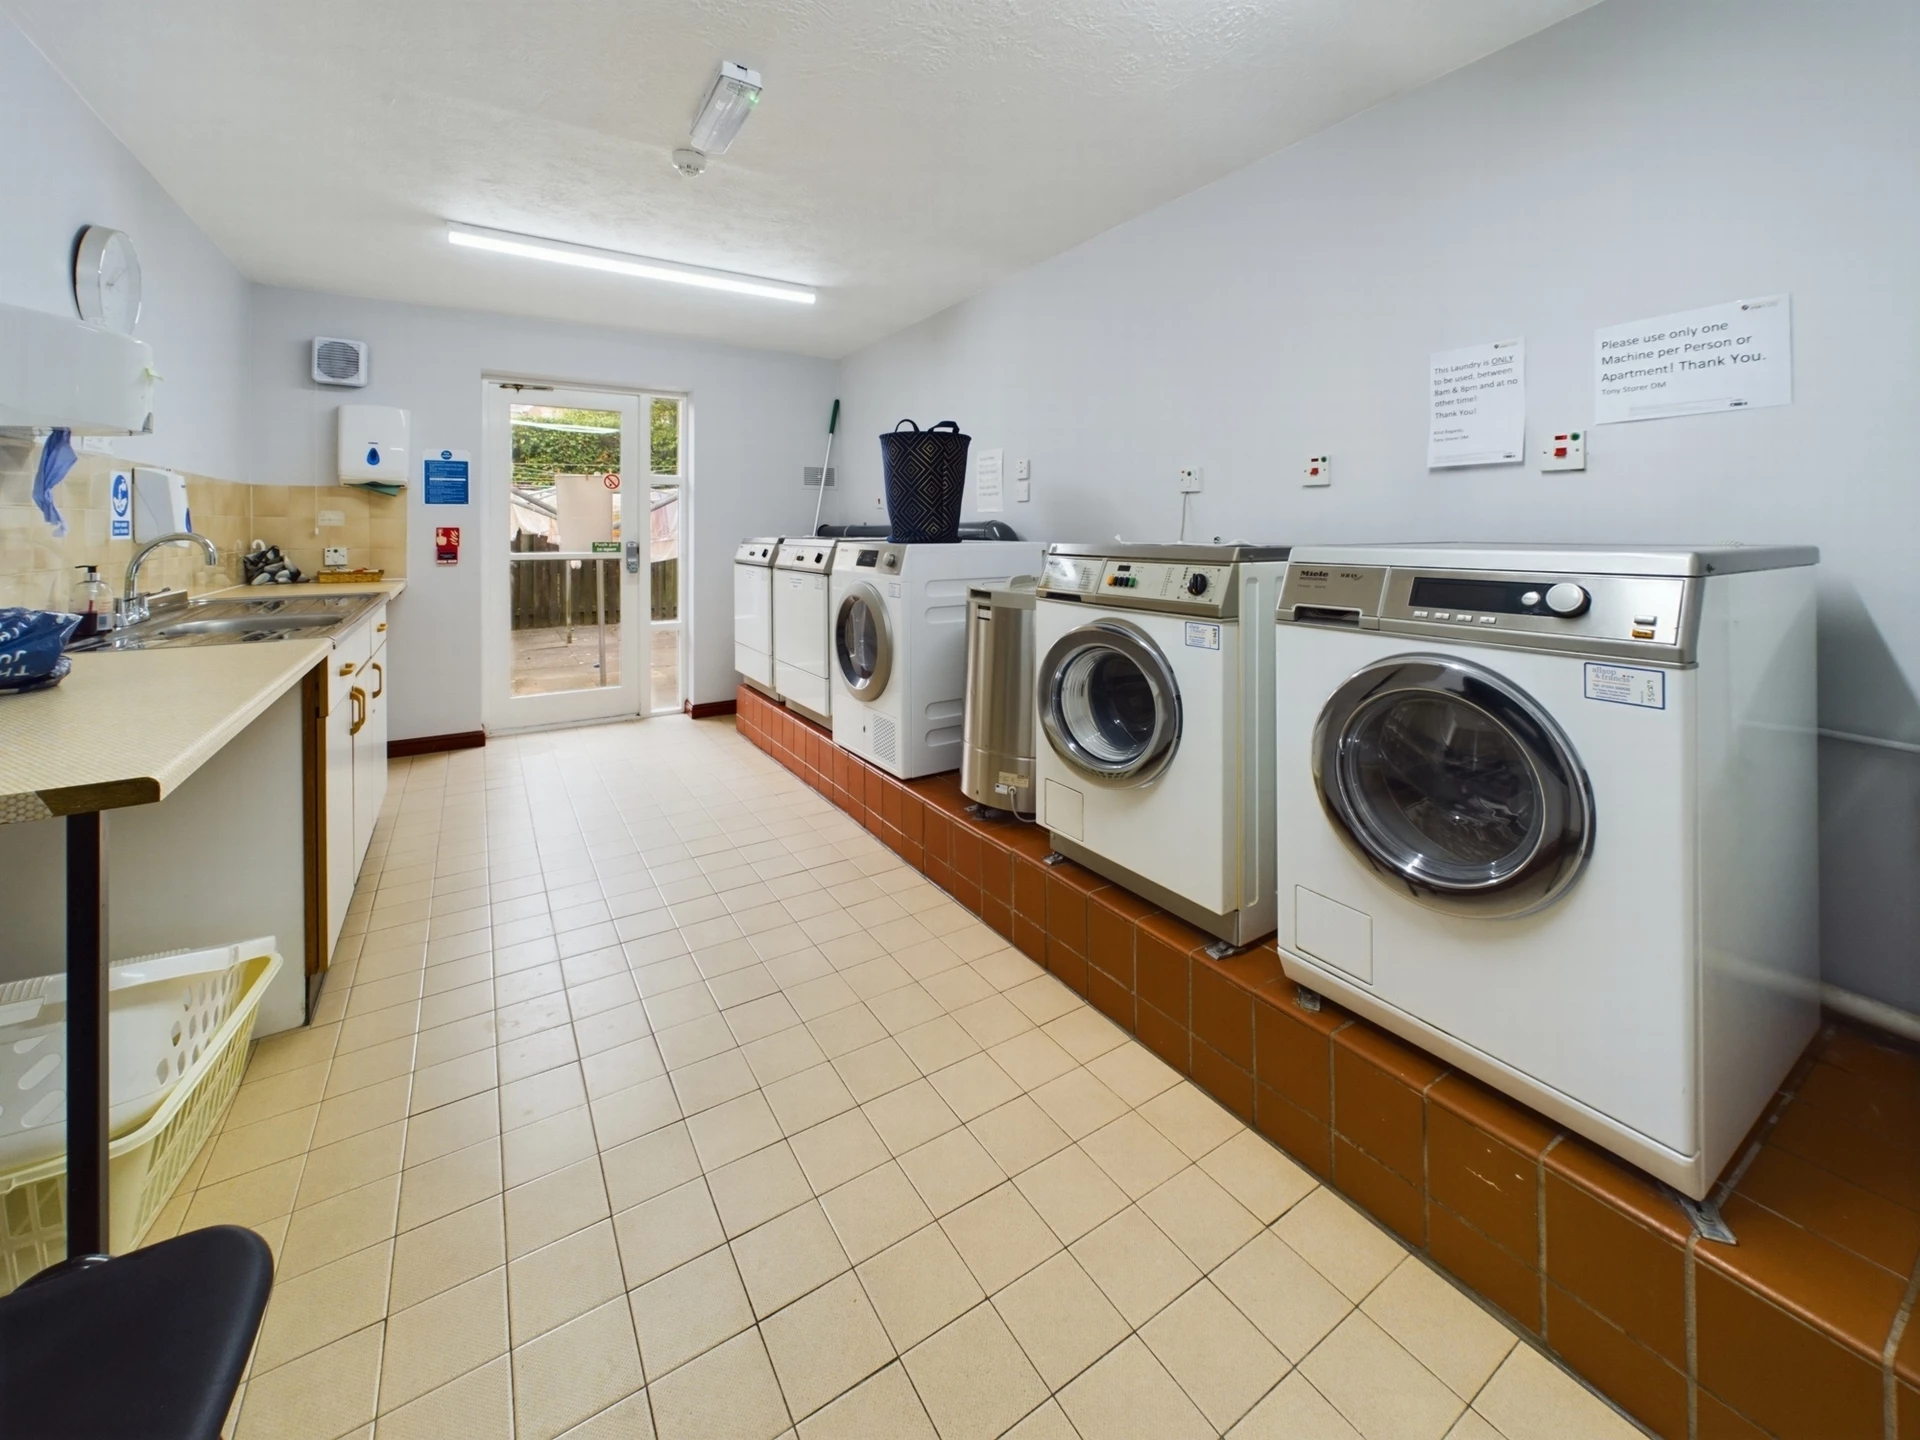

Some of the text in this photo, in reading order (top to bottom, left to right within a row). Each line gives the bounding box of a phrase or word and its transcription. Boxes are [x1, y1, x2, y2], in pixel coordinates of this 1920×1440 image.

[1601, 321, 1729, 351] Please use only one
[1601, 335, 1753, 365] Machine per Person or
[1434, 367, 1449, 375] This
[1450, 361, 1482, 373] Laundry
[1491, 355, 1514, 366] ONLY
[1477, 367, 1513, 379] between
[1601, 352, 1767, 383] Apartment! Thank You.
[1434, 389, 1451, 397] 8am
[1452, 386, 1458, 394] &
[1460, 385, 1478, 393] 8pm
[1479, 381, 1495, 390] and
[1496, 379, 1505, 387] at
[1601, 381, 1667, 395] Tony Storer DM
[1434, 395, 1477, 408] other time!
[1435, 408, 1477, 420] Thank You!
[1592, 666, 1617, 676] allsop
